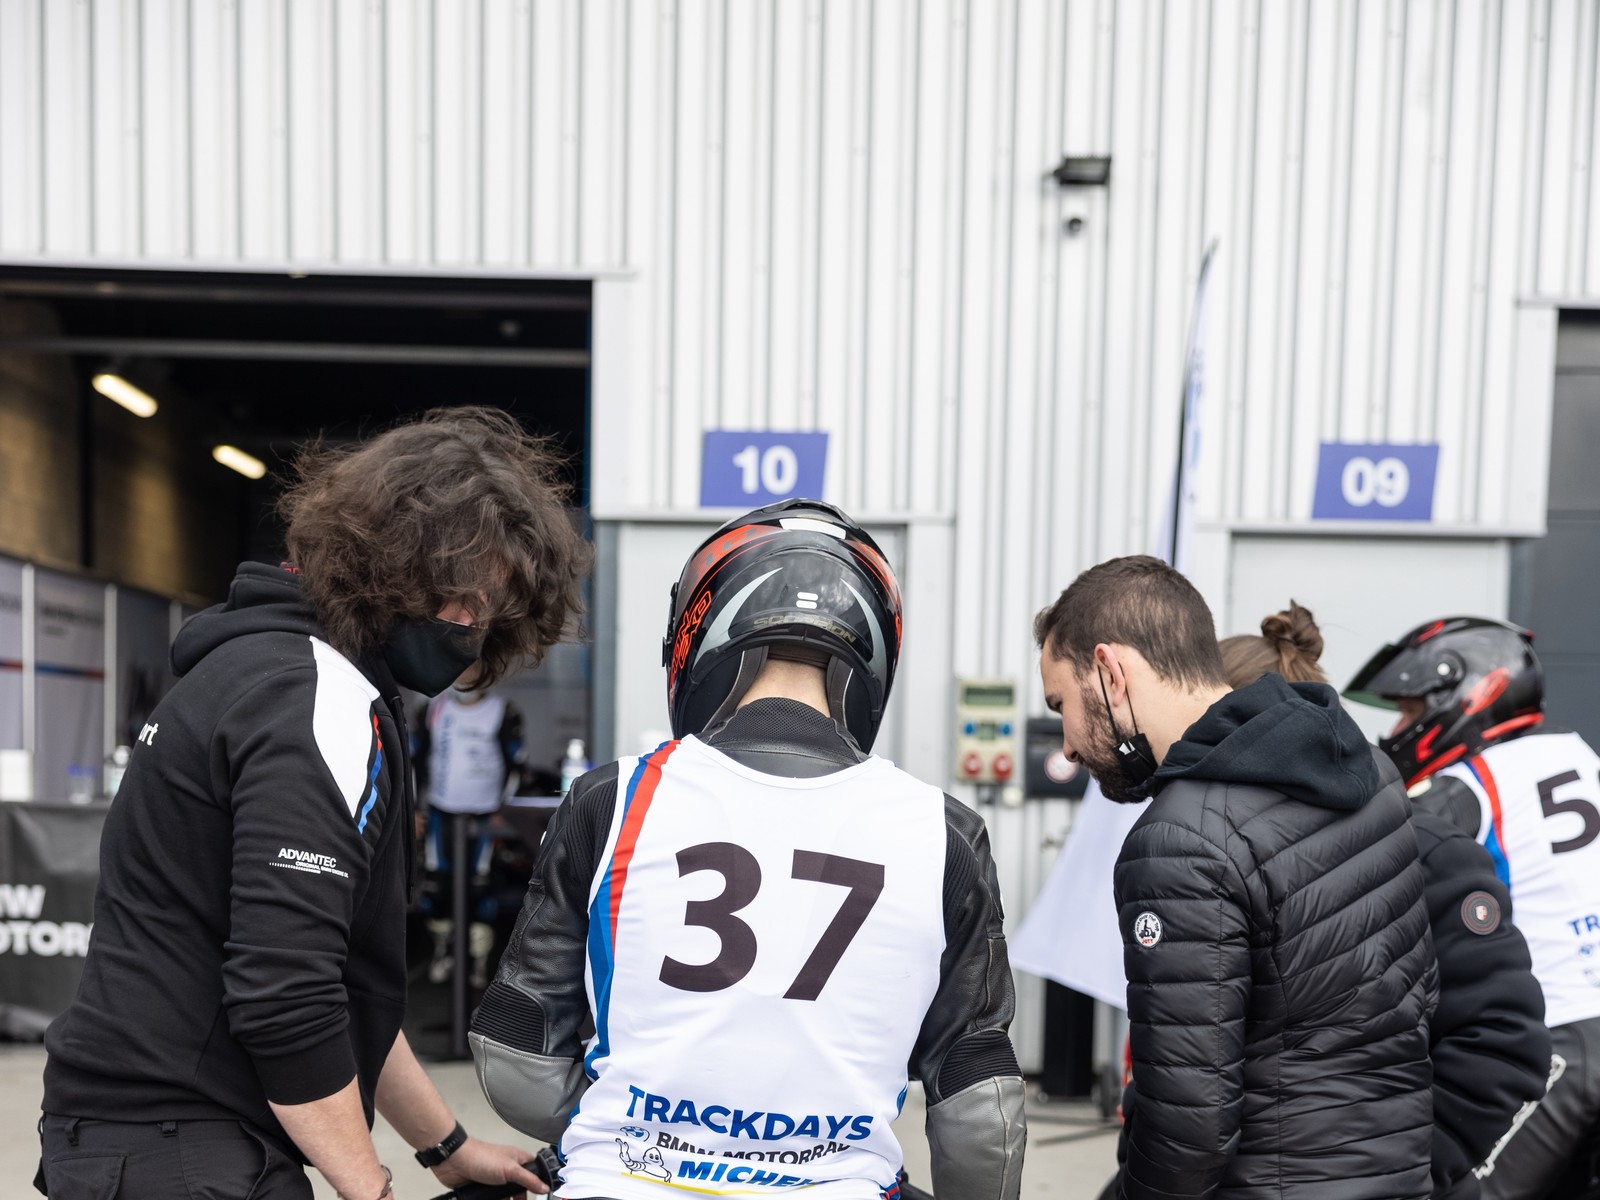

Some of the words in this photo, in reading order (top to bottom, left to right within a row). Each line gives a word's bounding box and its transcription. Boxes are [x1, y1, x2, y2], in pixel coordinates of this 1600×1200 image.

[732, 444, 798, 495] 10
[1341, 456, 1410, 507] 09
[278, 847, 337, 868] ADVANTEC
[658, 841, 885, 1002] 37
[626, 1084, 874, 1141] TRACKDAYS
